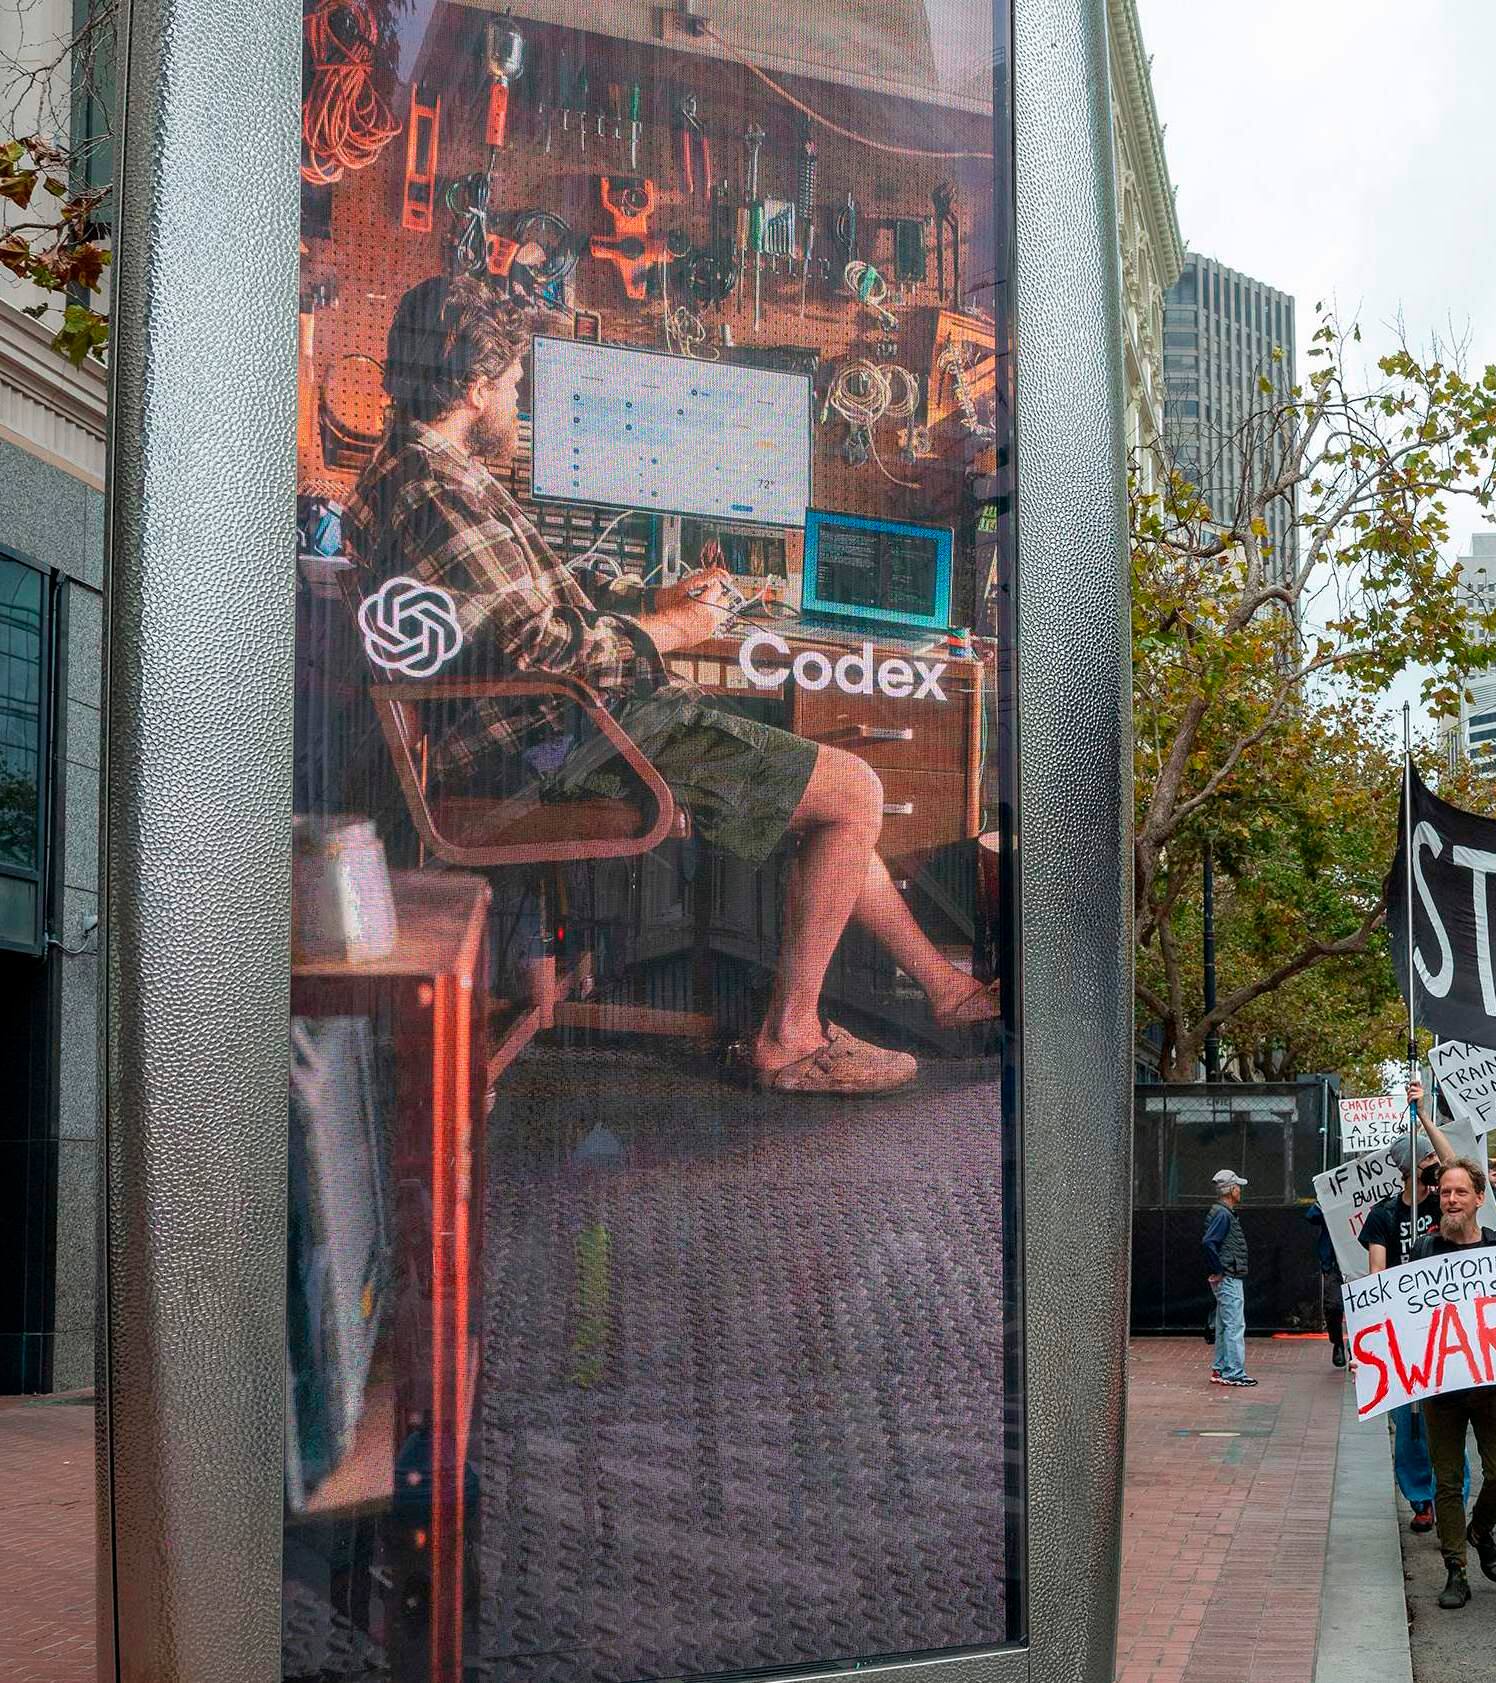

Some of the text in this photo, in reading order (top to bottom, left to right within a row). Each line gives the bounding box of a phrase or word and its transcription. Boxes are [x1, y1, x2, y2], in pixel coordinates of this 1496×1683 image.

[738, 630, 948, 702] Codex
[1438, 1042, 1481, 1066] MA
[1340, 1097, 1393, 1112] CHATGPT
[1346, 1134, 1381, 1149] THIS
[1351, 1125, 1362, 1135] A
[1328, 1168, 1348, 1197] IF
[1356, 1159, 1383, 1187] NO
[1352, 1177, 1404, 1208] BUILDS
[1344, 1273, 1394, 1313] task
